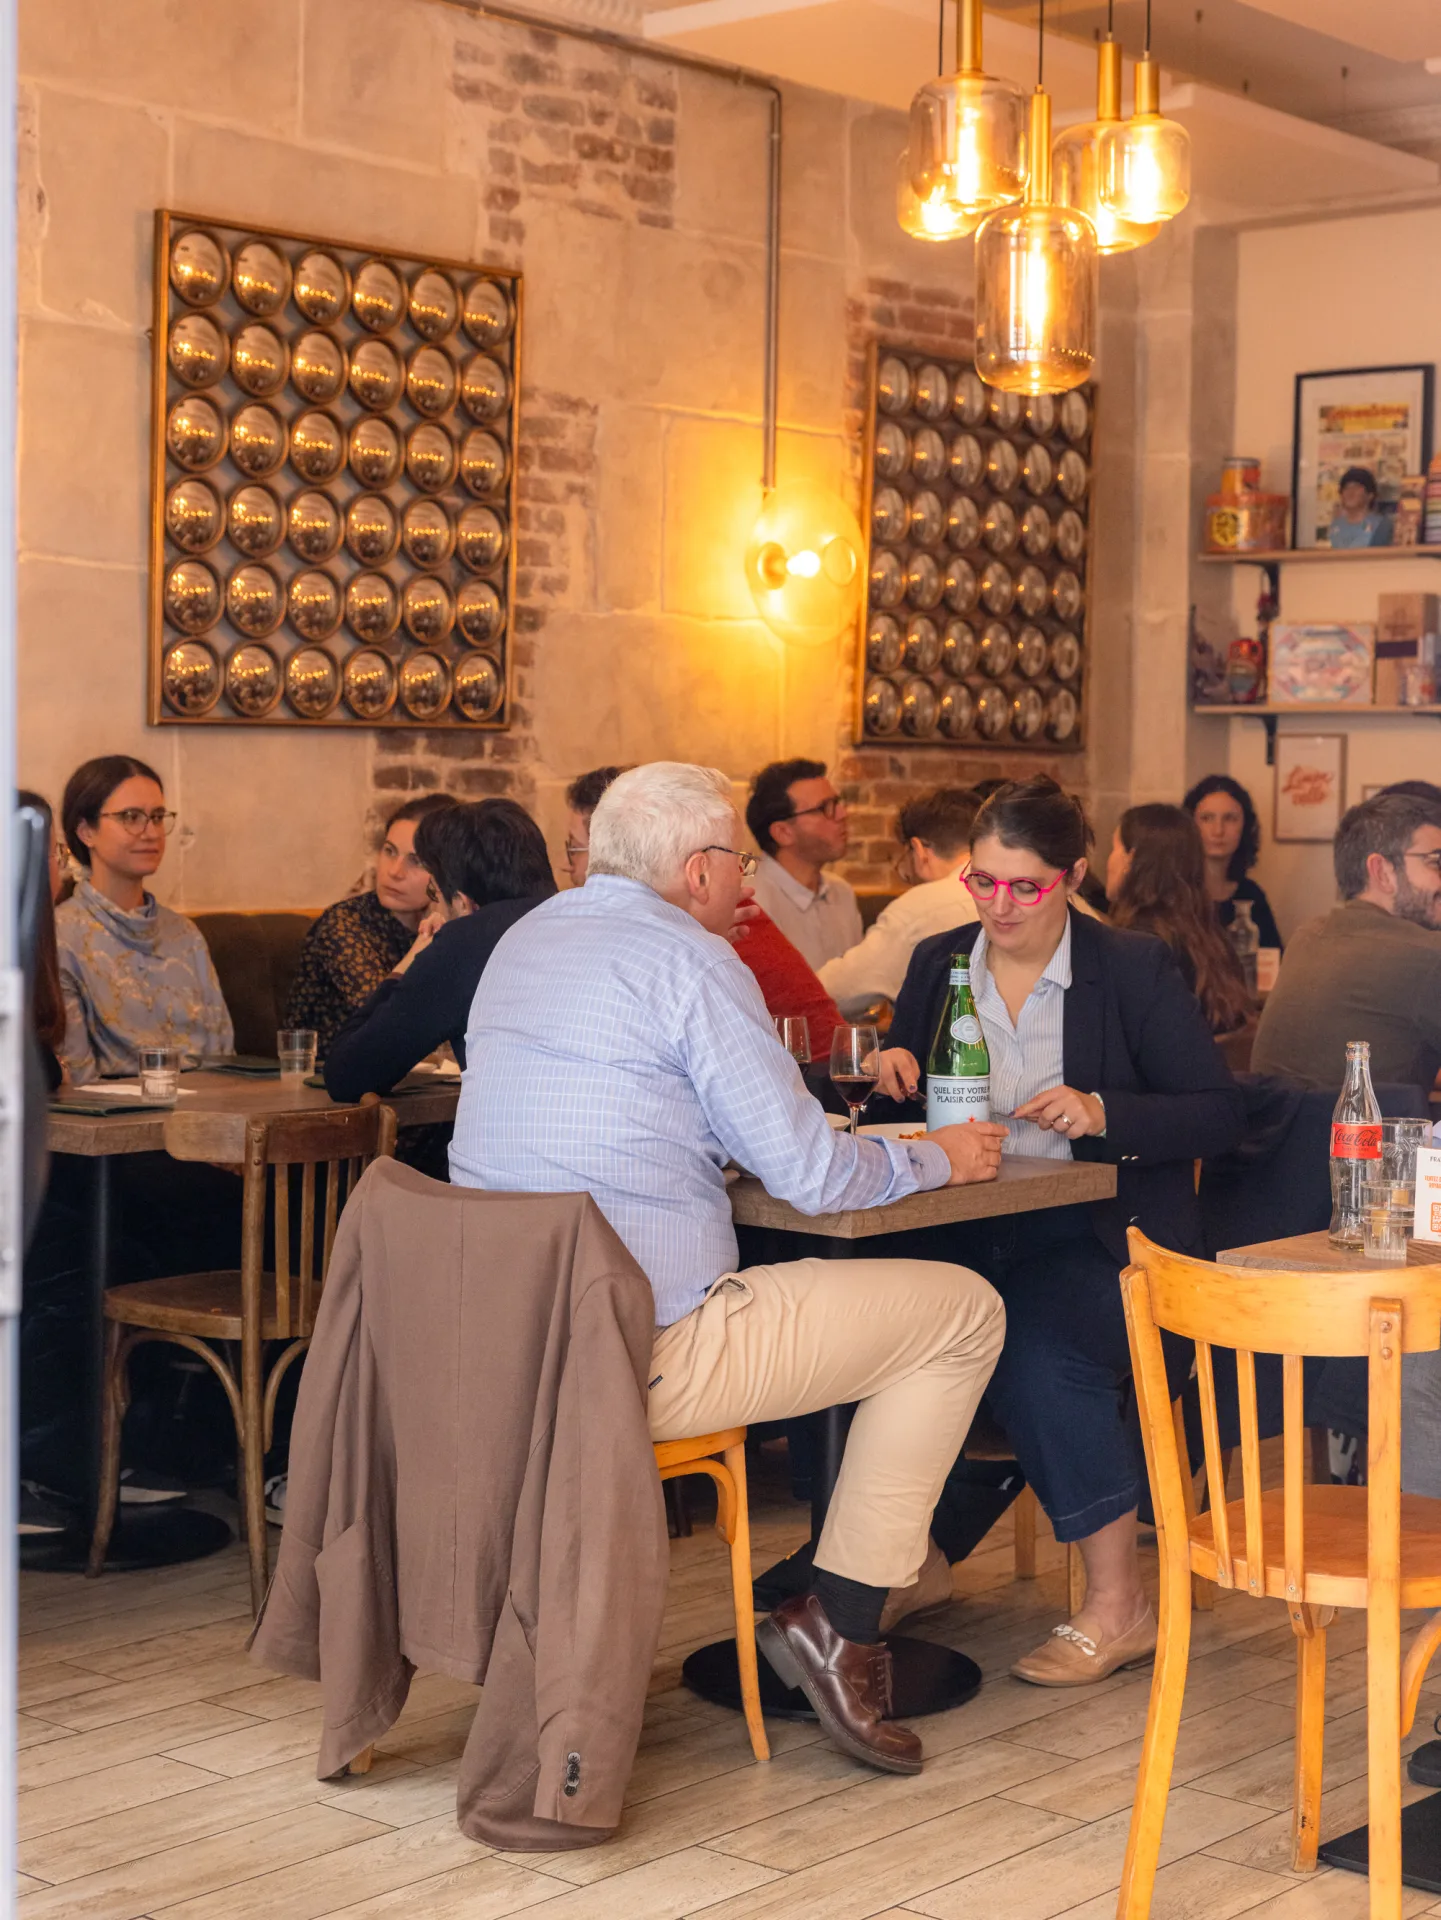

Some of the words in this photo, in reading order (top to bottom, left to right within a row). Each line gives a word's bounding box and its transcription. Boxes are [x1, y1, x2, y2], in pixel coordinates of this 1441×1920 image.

[934, 1086, 950, 1095] QUEL
[953, 1087, 965, 1095] EST
[967, 1086, 987, 1094] VOTRE
[1335, 1129, 1377, 1146] Coca-Cola
